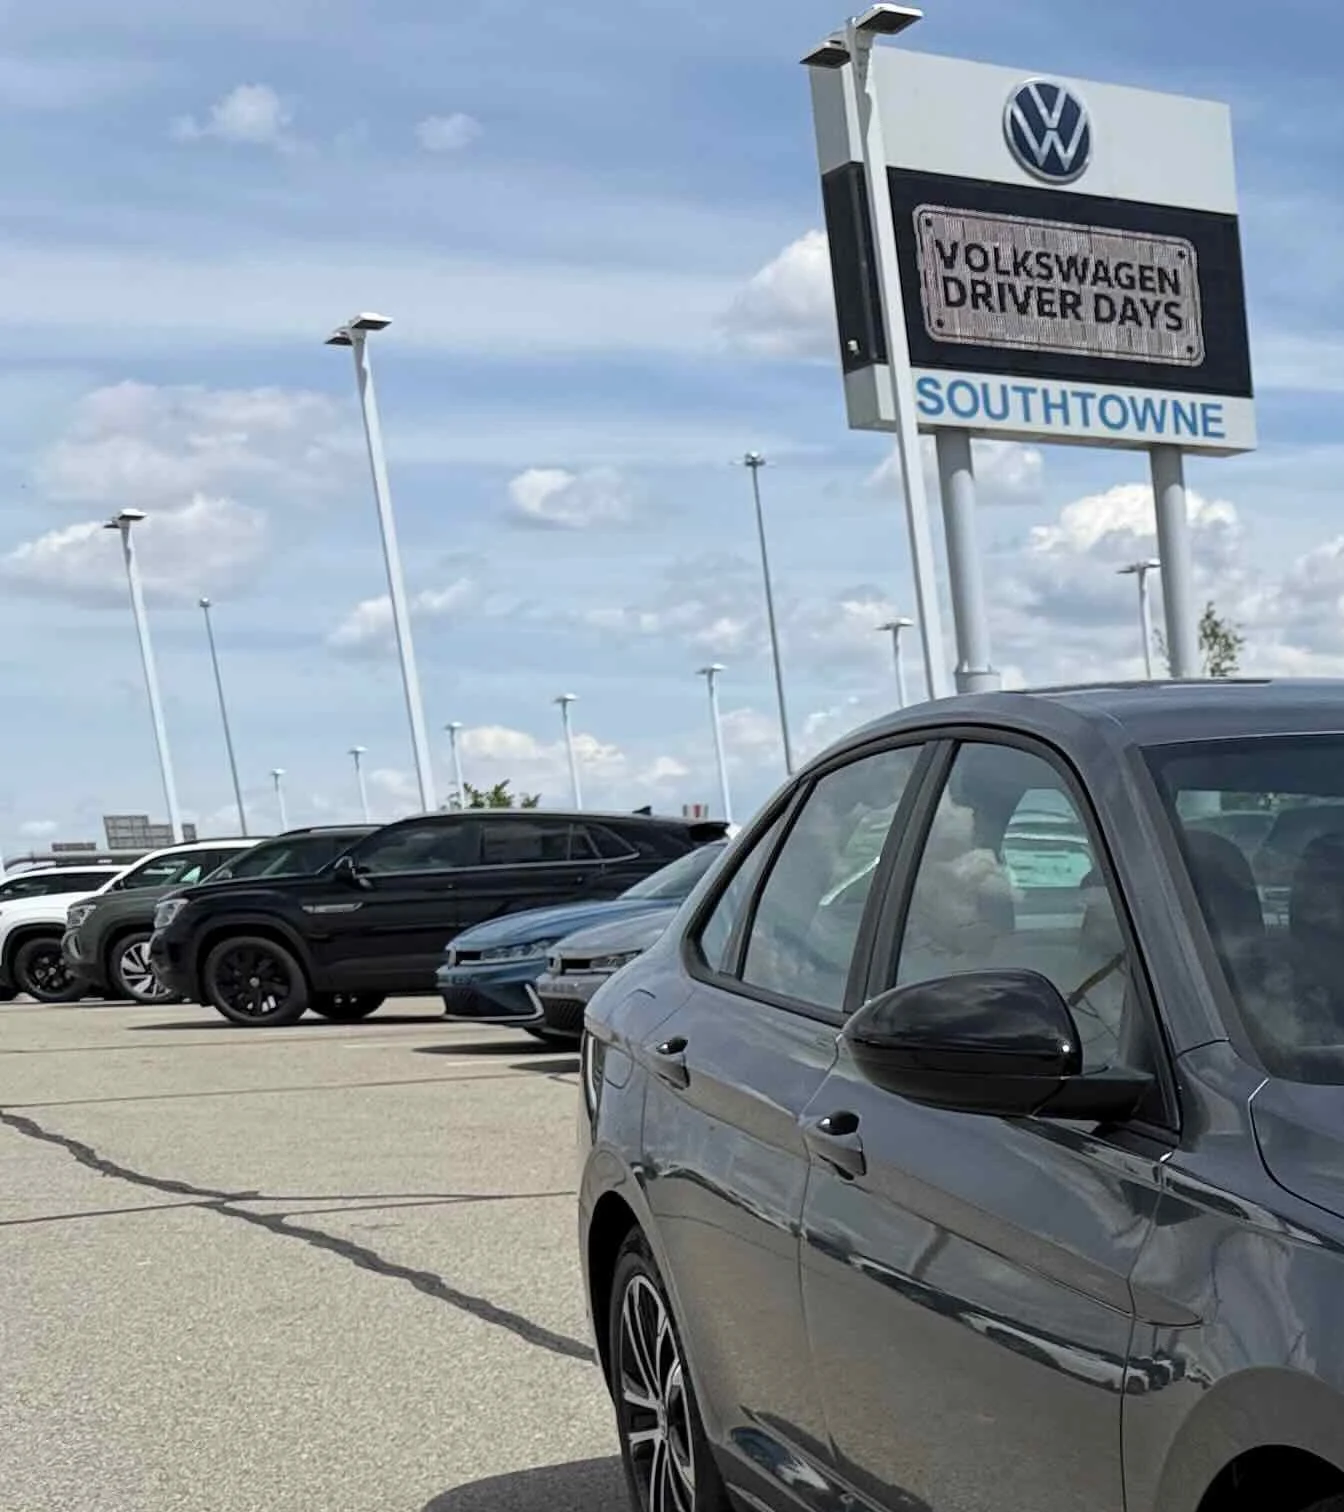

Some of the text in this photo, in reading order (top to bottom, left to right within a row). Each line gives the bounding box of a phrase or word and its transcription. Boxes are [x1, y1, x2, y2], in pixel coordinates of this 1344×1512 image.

[1004, 80, 1092, 183] VW
[935, 239, 1181, 296] VOLKSWAGEN
[943, 276, 1184, 331] DRIVER DAYS
[916, 376, 1226, 439] SOUTHTOWNE
